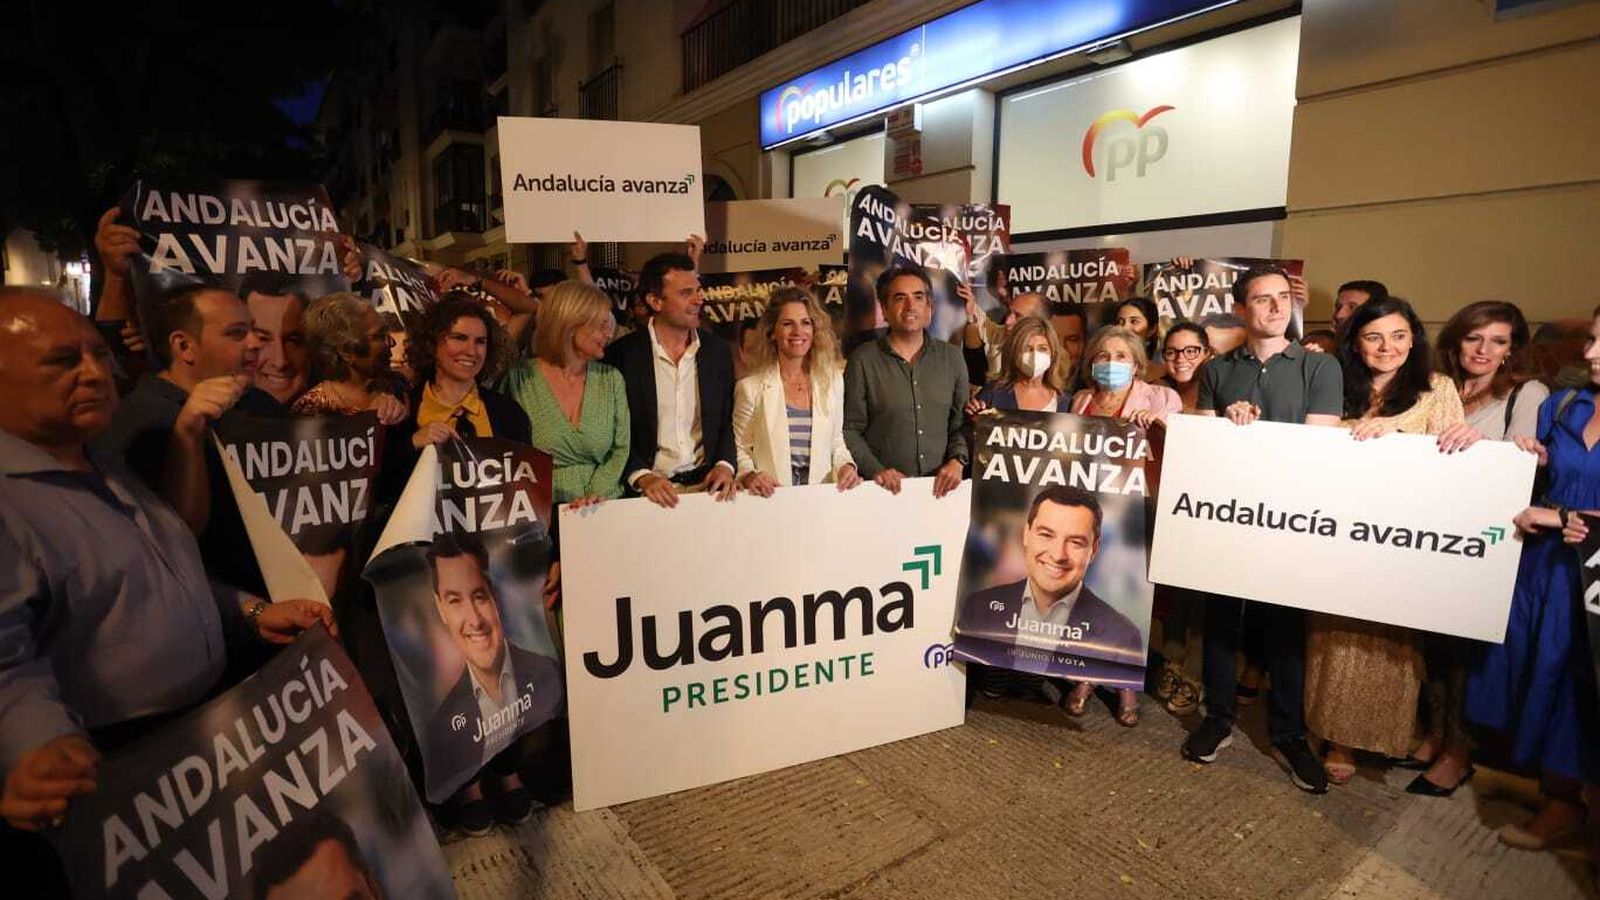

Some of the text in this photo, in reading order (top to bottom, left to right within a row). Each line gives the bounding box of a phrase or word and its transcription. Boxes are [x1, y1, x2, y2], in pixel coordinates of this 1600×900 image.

[513, 173, 689, 195] Andalucía avanza
[142, 190, 339, 233] ANDALUCÍA
[149, 232, 339, 275] AVANZA
[703, 239, 830, 254] dalucía avanza
[1008, 256, 1120, 283] ANDALUCÍA
[225, 426, 375, 480] ANDALUCÍ
[986, 425, 1155, 462] ANDALUCÍA
[436, 452, 539, 490] LUCÍA
[982, 453, 1151, 497] AVANZA
[1172, 493, 1486, 558] Andalucía avanza
[583, 581, 914, 679] Juanma
[1005, 612, 1083, 641] Juanma
[662, 652, 875, 713] PRESIDENTE
[472, 693, 533, 743] Juanma
[103, 656, 349, 889] ANDALUCÍA
